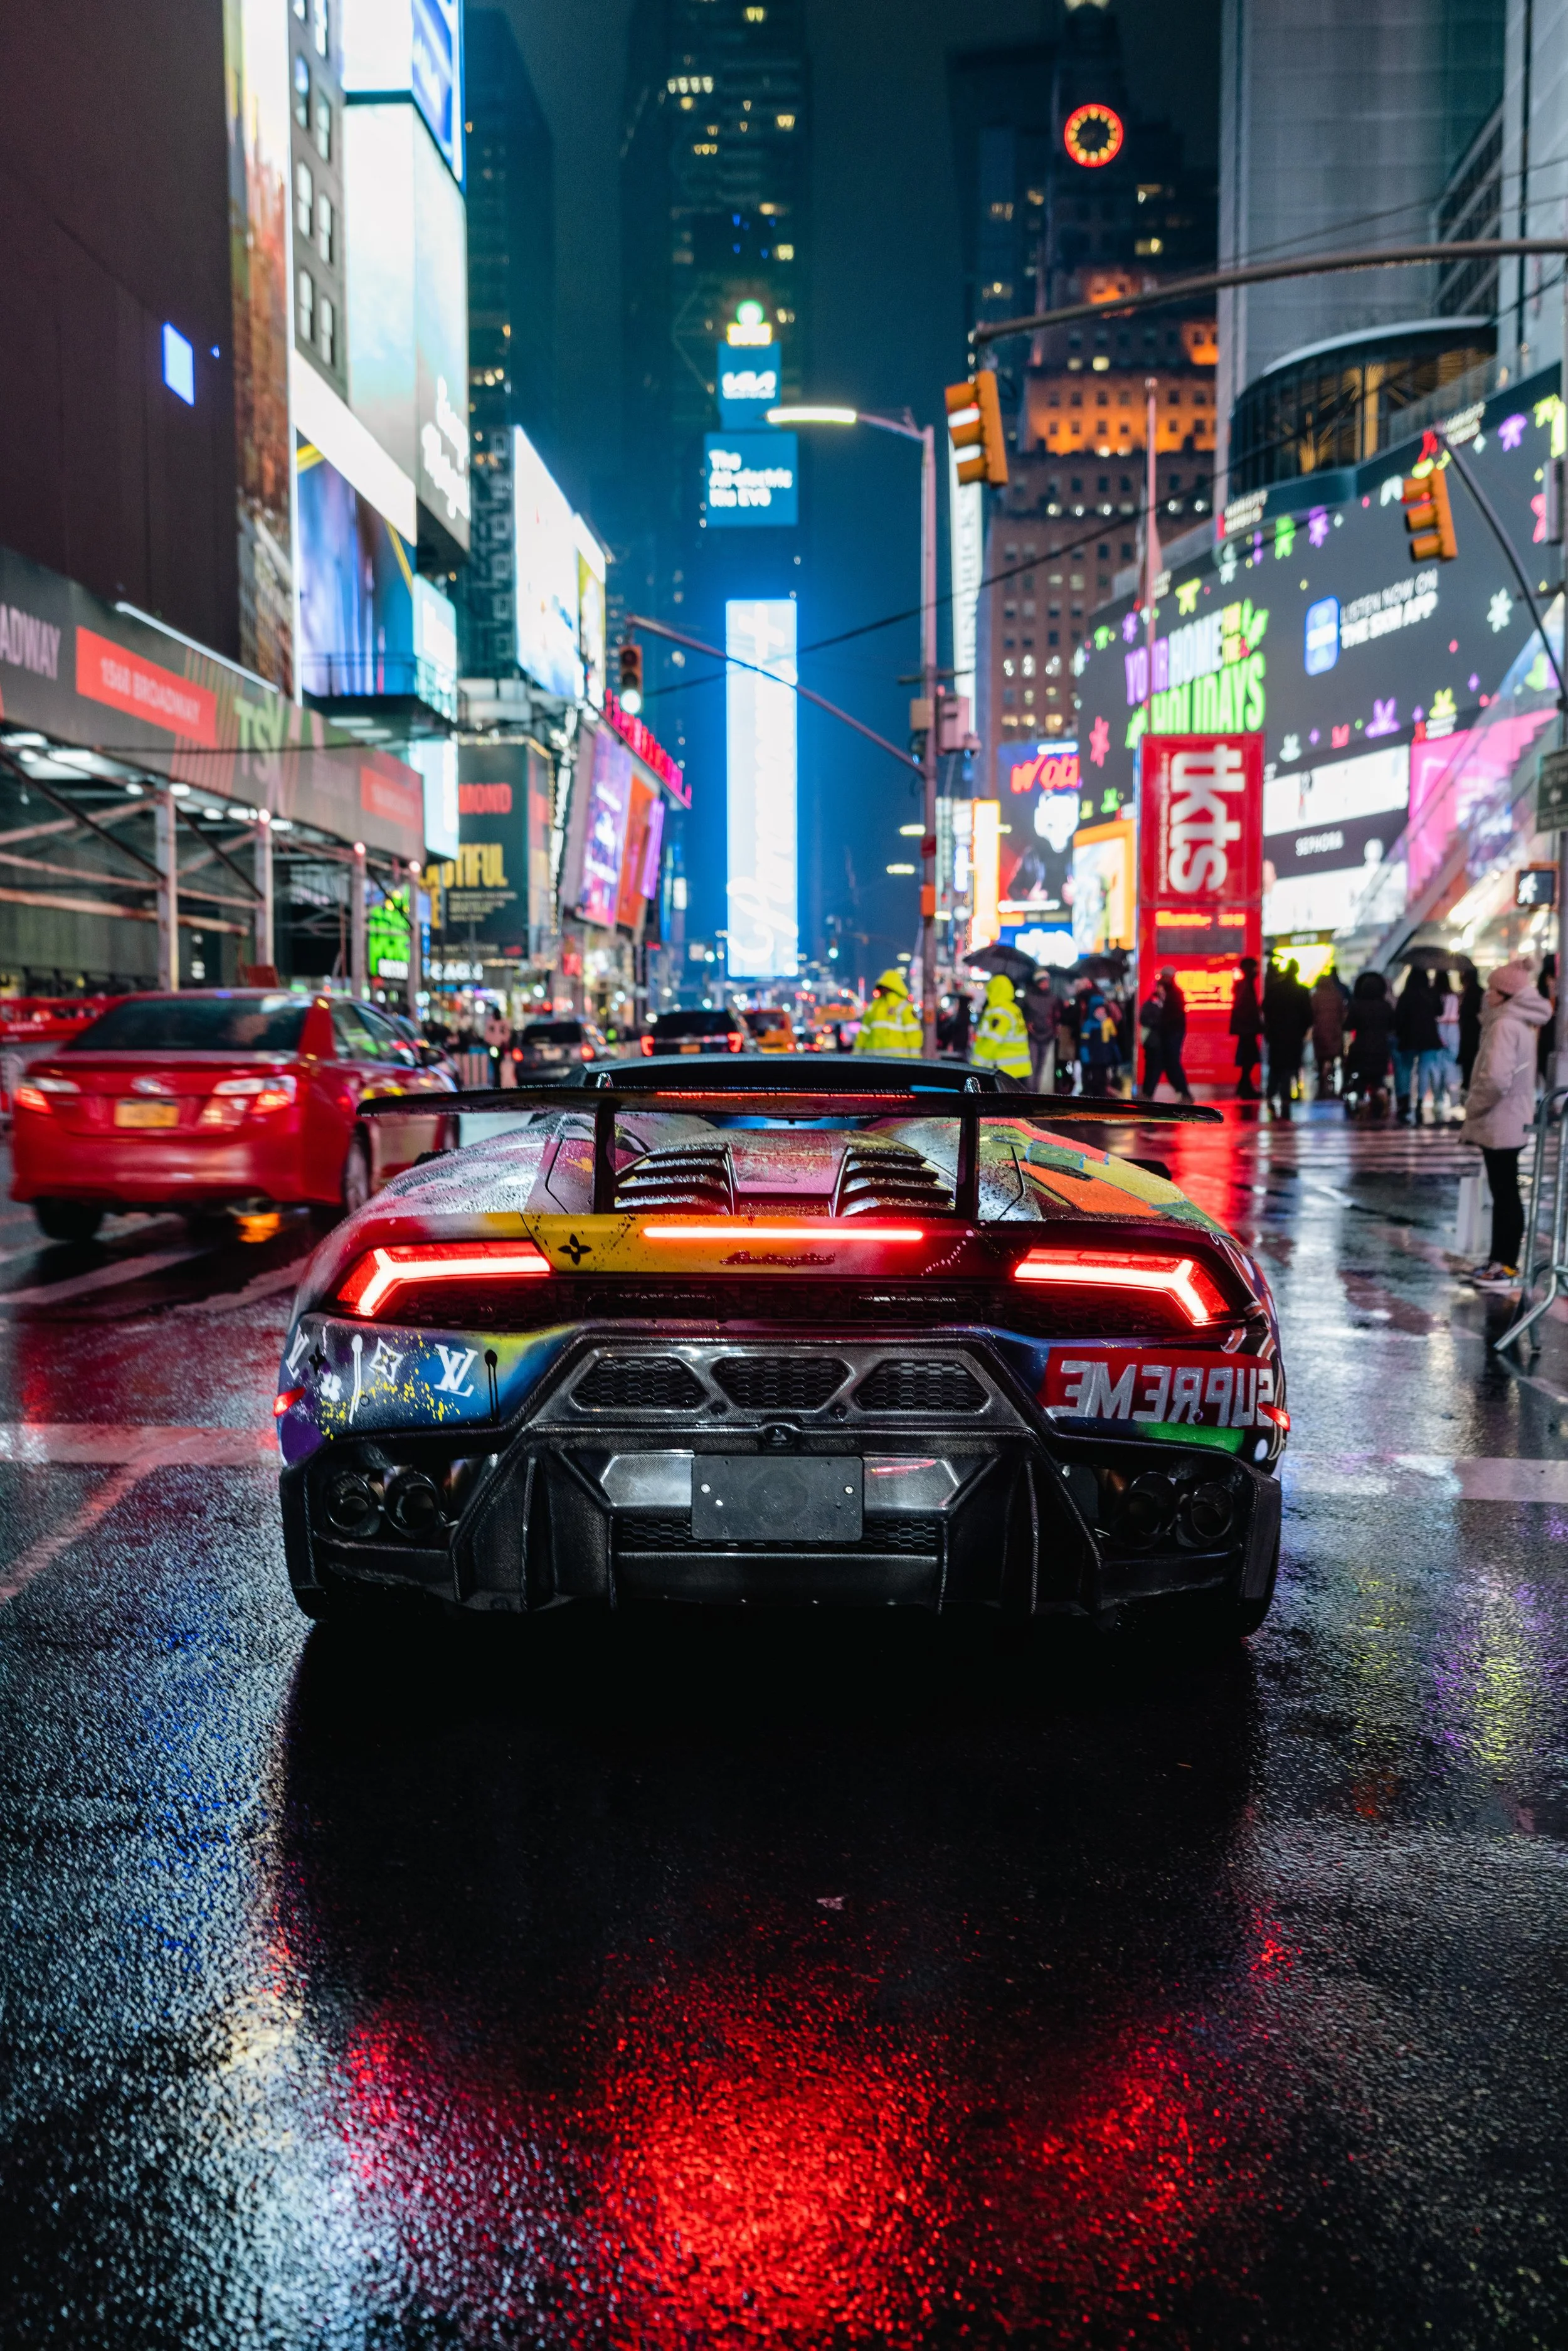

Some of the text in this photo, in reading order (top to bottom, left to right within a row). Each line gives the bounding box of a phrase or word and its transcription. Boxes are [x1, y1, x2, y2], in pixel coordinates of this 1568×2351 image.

[1382, 578, 1415, 608] NOW
[1415, 567, 1438, 597] ON
[1168, 609, 1223, 689] HOME
[1168, 744, 1245, 893] tkts
